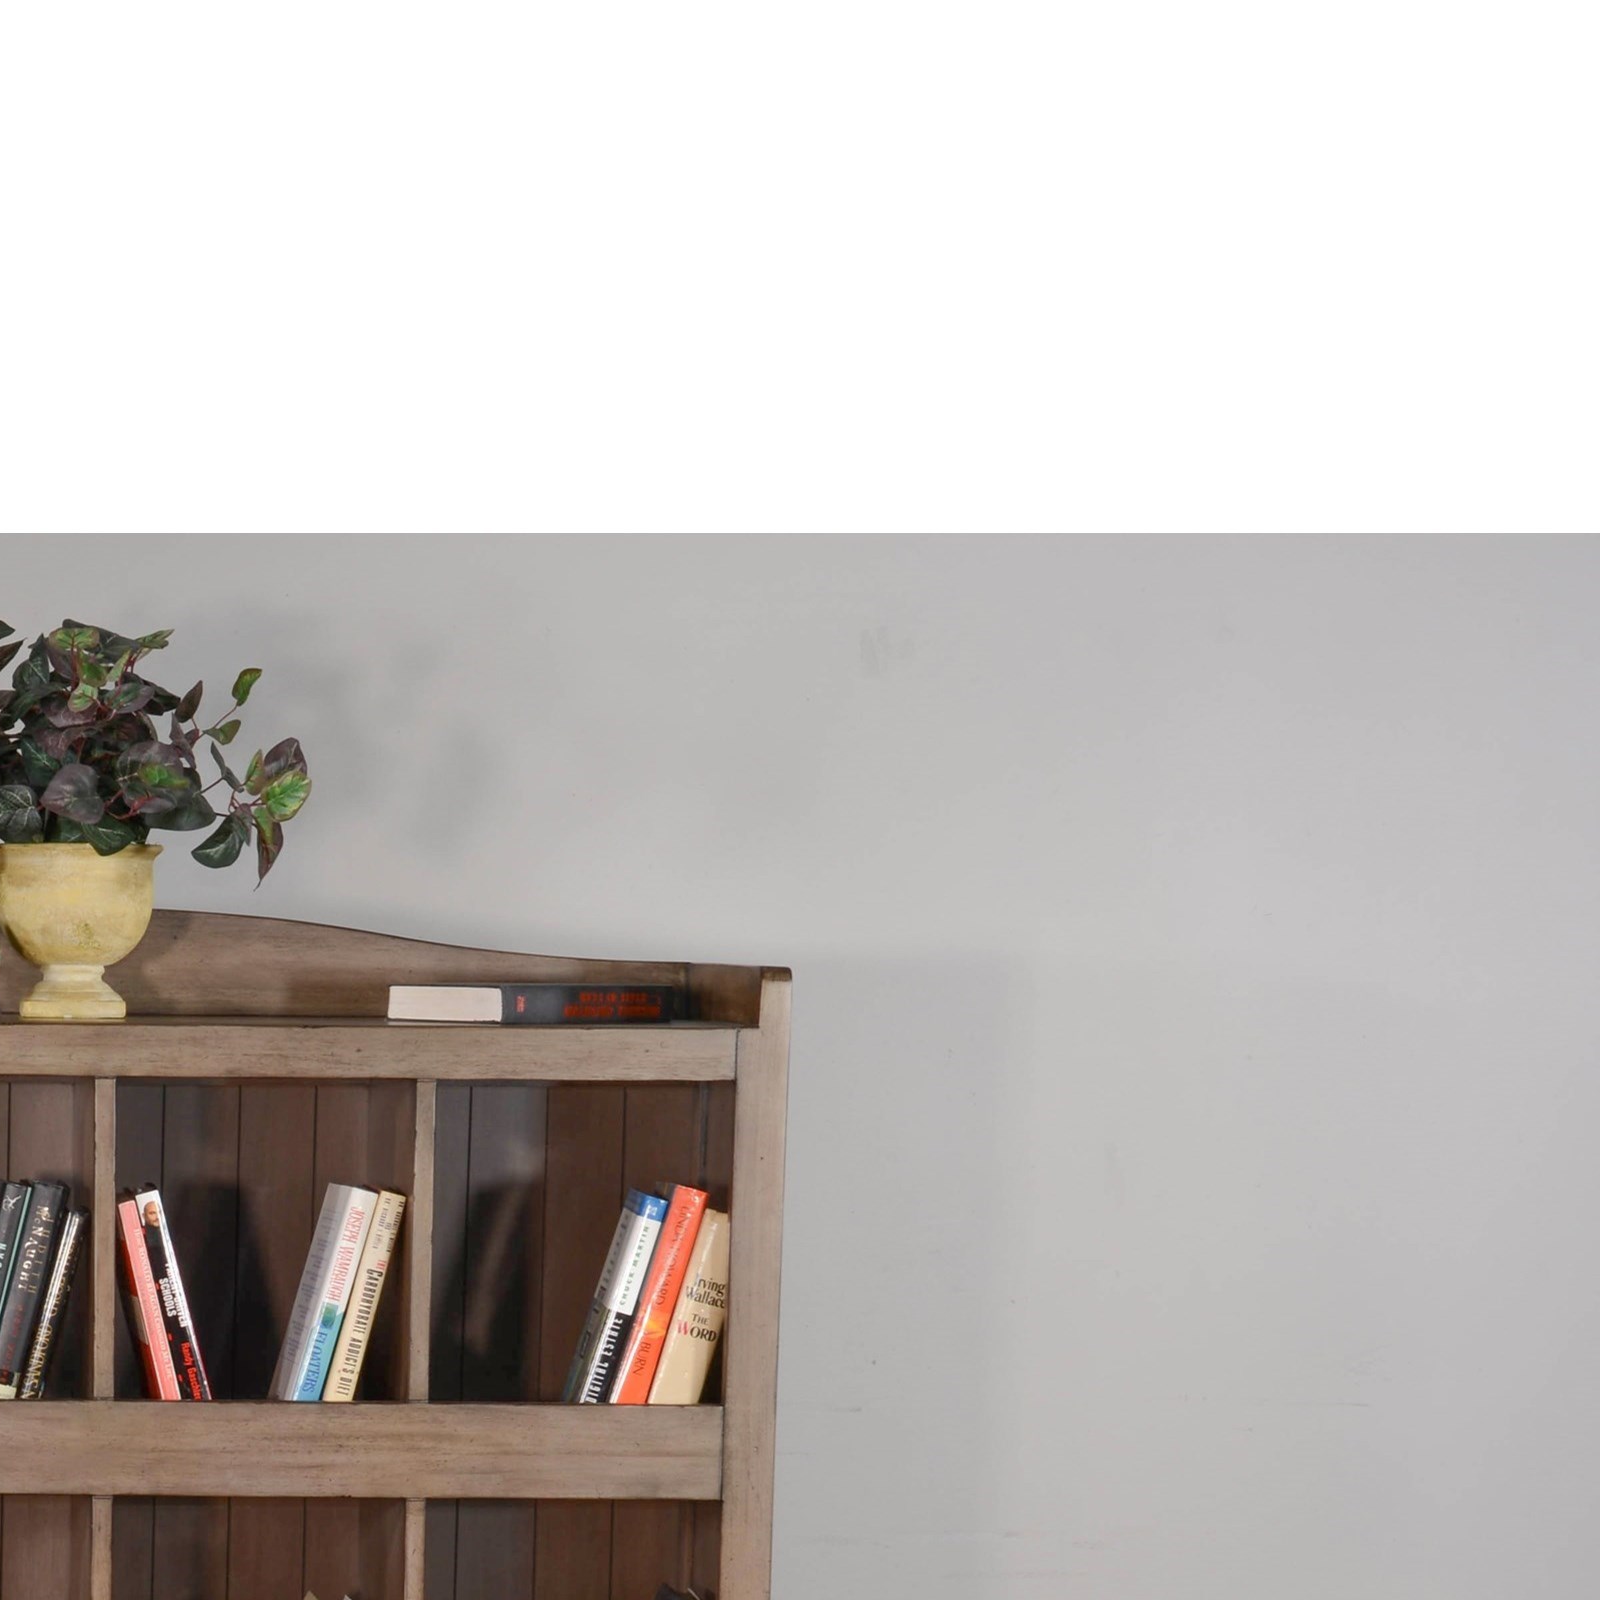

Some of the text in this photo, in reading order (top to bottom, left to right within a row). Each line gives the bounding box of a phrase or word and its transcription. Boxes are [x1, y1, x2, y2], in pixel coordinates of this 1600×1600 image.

[342, 1207, 366, 1244] JOSEPH
[327, 1246, 355, 1302] WAMBAUGH
[619, 1226, 649, 1306] CHUCK MARTIN
[652, 1207, 693, 1306] LINDA HOWARD
[159, 1278, 177, 1317] SCHOOLS
[353, 1269, 383, 1334] CARBOHYDRATE
[695, 1272, 726, 1297] Irving
[677, 1320, 718, 1342] WORD
[692, 1313, 709, 1326] THE
[24, 1322, 51, 1388] SANDFORD
[181, 1341, 194, 1366] Randy
[301, 1331, 328, 1394] FLOATERS
[342, 1337, 362, 1374] ADDICT'S
[633, 1342, 651, 1375] BURN
[336, 1377, 352, 1396] DIET
